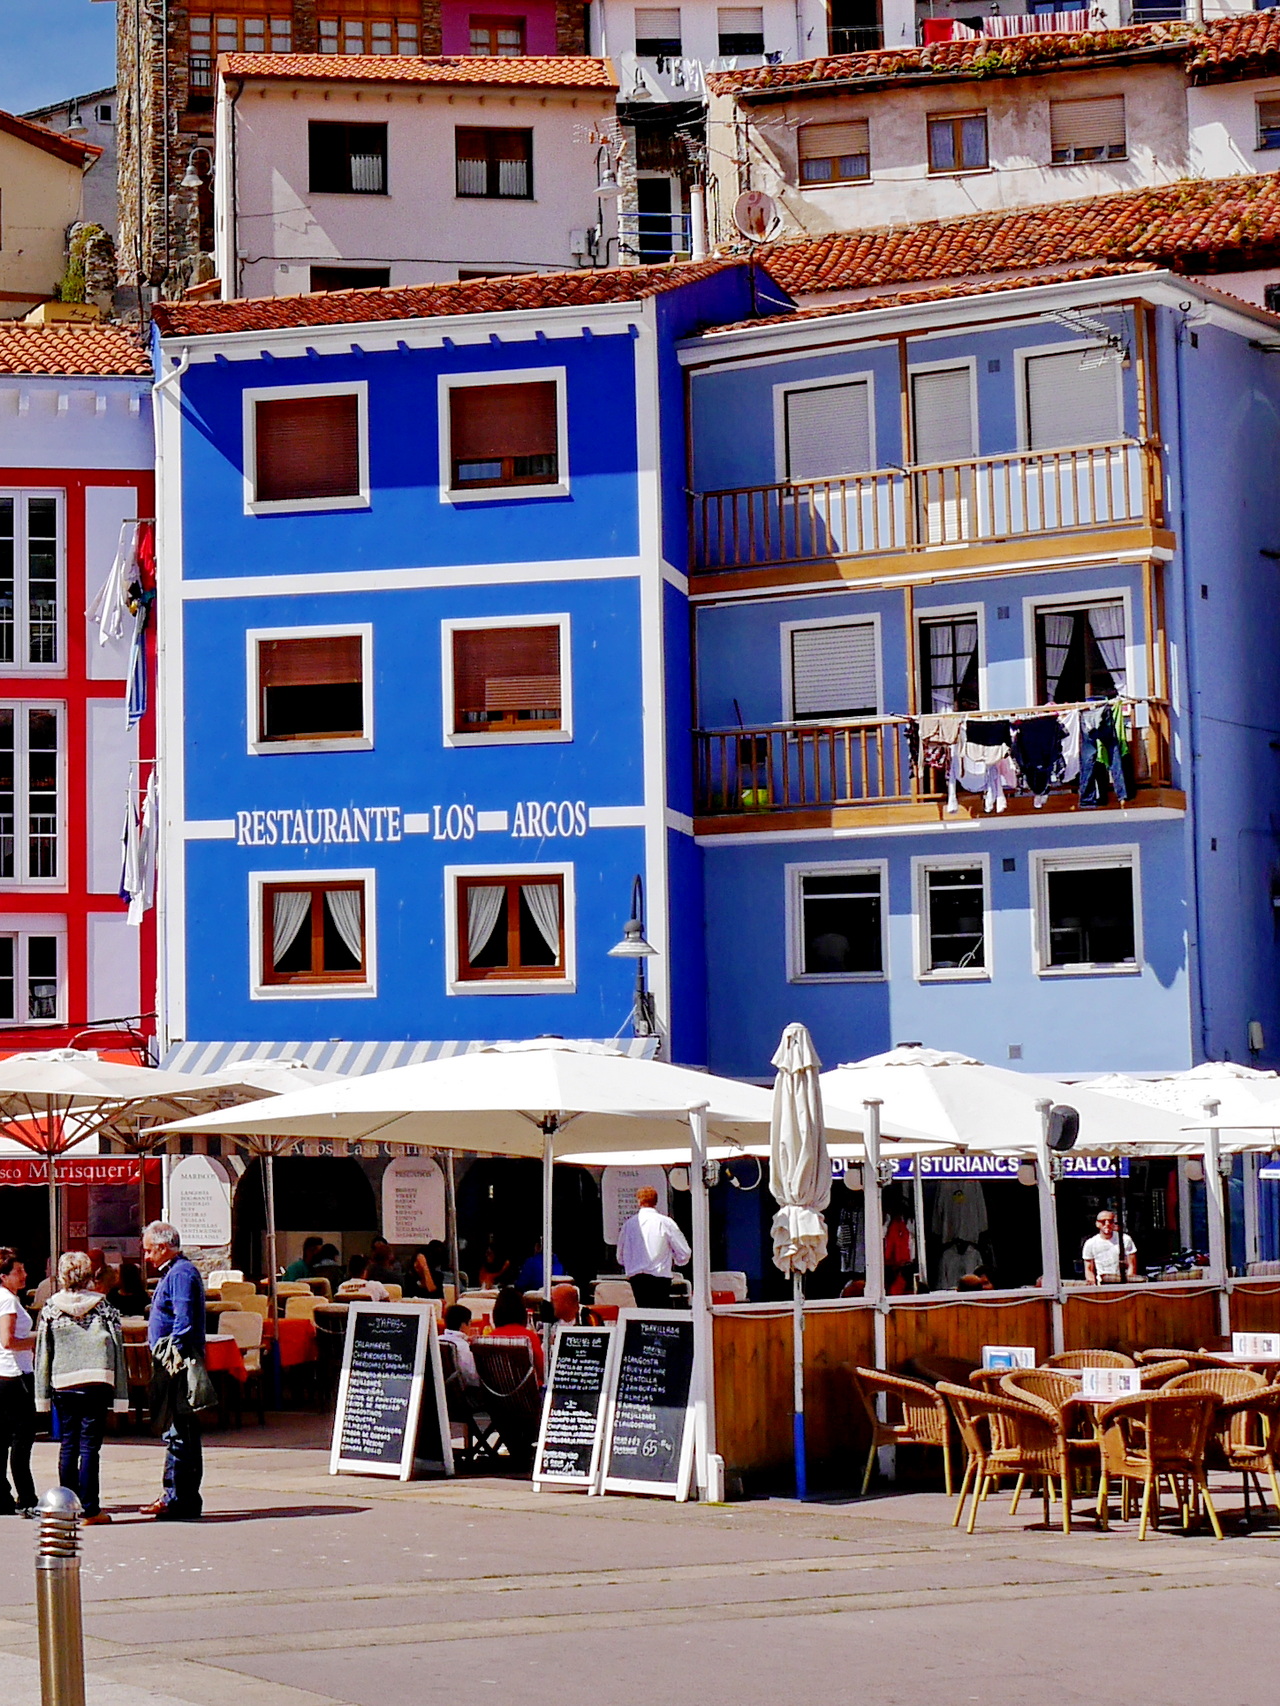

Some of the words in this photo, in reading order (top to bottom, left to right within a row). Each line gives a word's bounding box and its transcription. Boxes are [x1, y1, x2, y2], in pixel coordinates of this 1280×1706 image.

[236, 806, 401, 846] RESTAURANTE
[432, 803, 475, 841] LOS
[511, 800, 587, 838] ARCOS
[642, 1439, 658, 1457] 65
